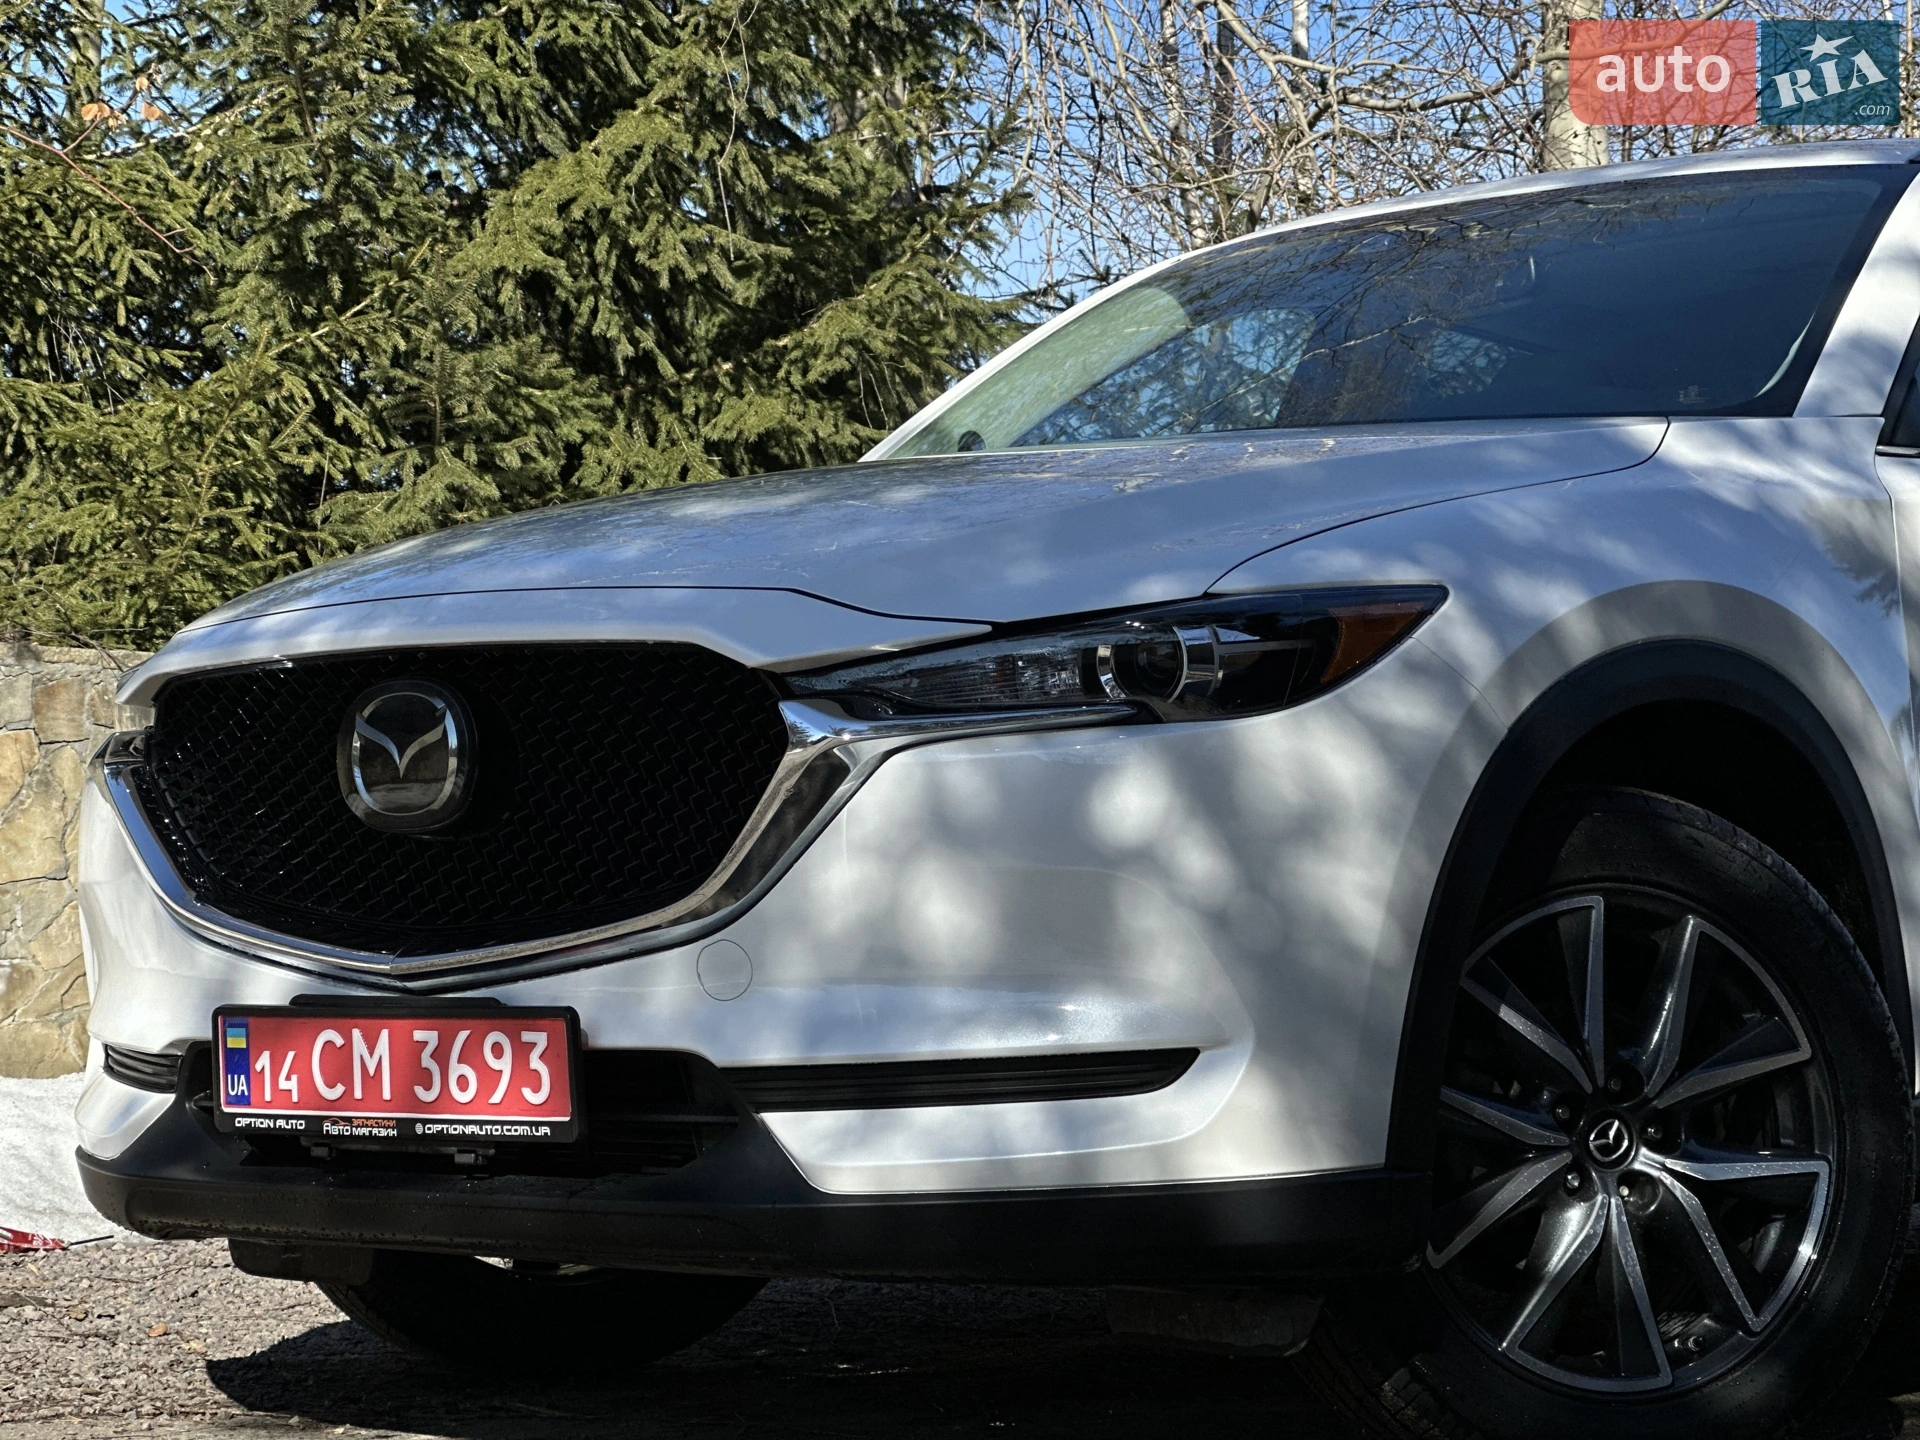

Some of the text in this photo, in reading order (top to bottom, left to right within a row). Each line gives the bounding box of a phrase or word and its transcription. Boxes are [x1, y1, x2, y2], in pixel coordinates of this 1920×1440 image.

[254, 1028, 551, 1106] 14 CM 3693
[227, 1075, 249, 1096] UA
[275, 1120, 306, 1130] AUTO
